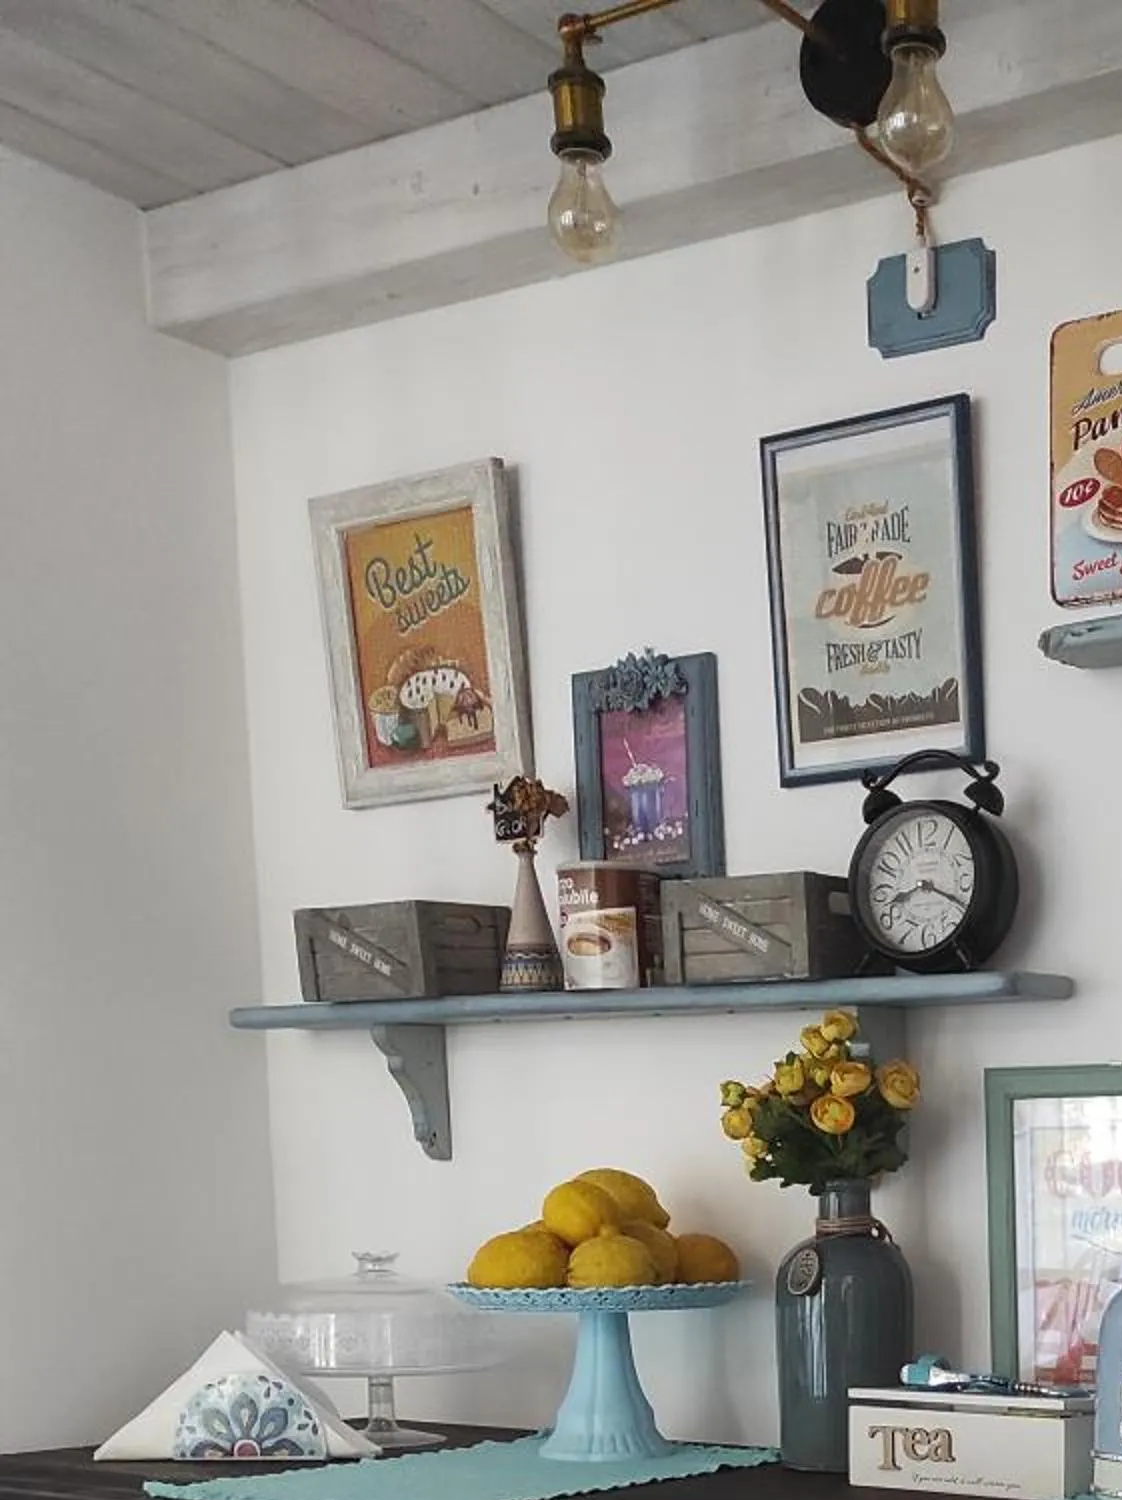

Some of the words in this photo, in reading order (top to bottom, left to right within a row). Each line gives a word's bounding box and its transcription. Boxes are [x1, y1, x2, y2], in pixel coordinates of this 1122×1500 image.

[365, 531, 438, 609] Best
[1072, 551, 1119, 581] Sweet
[395, 561, 471, 635] sweets
[815, 555, 931, 626] coffee
[826, 641, 865, 674] FRESH
[883, 627, 922, 660] TASTY
[916, 819, 939, 849] 12
[877, 851, 902, 879] 10
[866, 1424, 957, 1472] Tea
